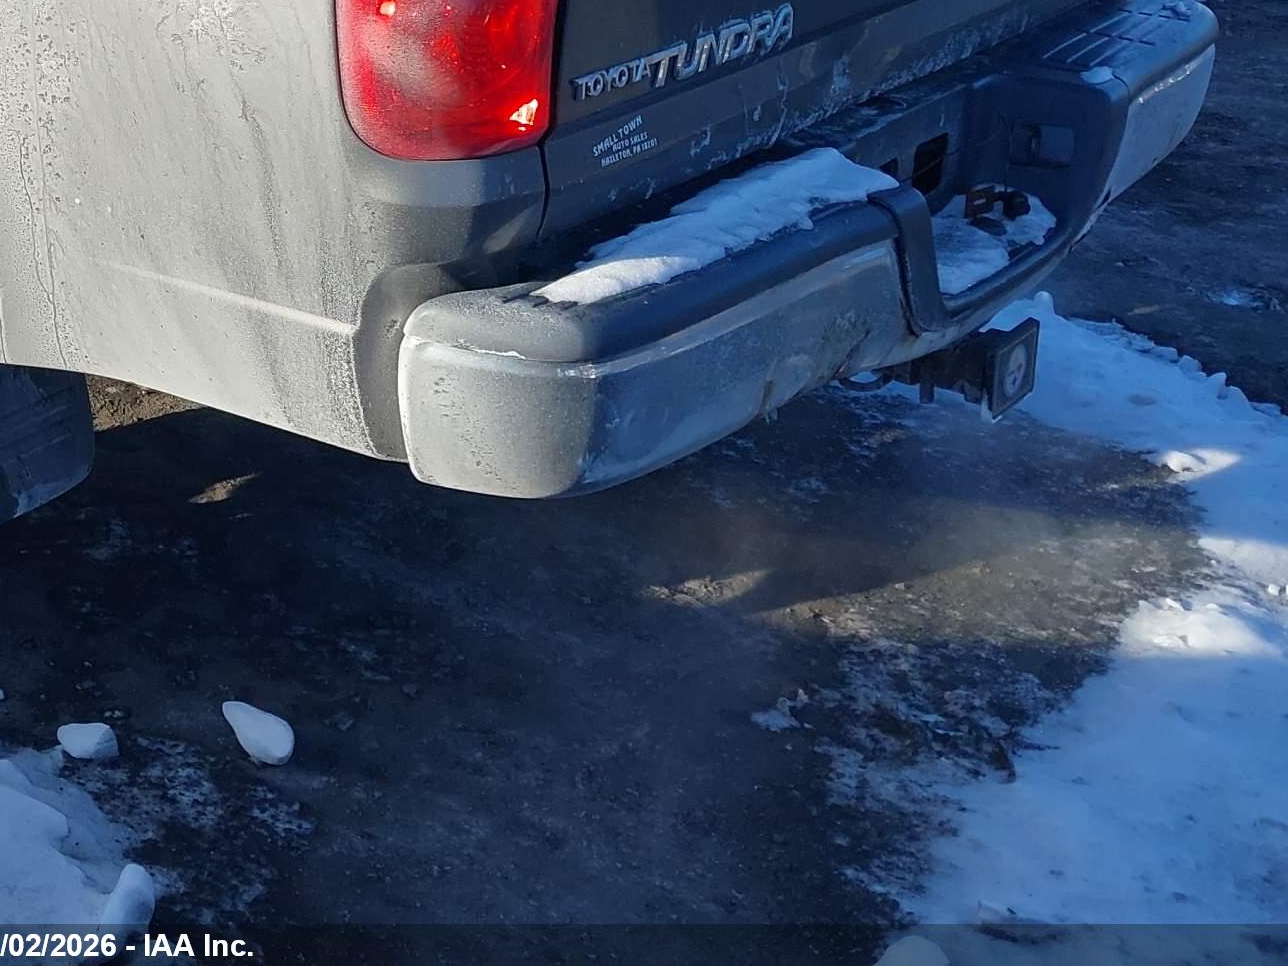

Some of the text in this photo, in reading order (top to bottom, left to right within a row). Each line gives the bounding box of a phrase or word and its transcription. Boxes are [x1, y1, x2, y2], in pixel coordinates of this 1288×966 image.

[572, 2, 793, 101] TOYOTA TUNDRA
[593, 114, 643, 157] SMALL TOWN
[613, 131, 648, 152] AUTO SALES
